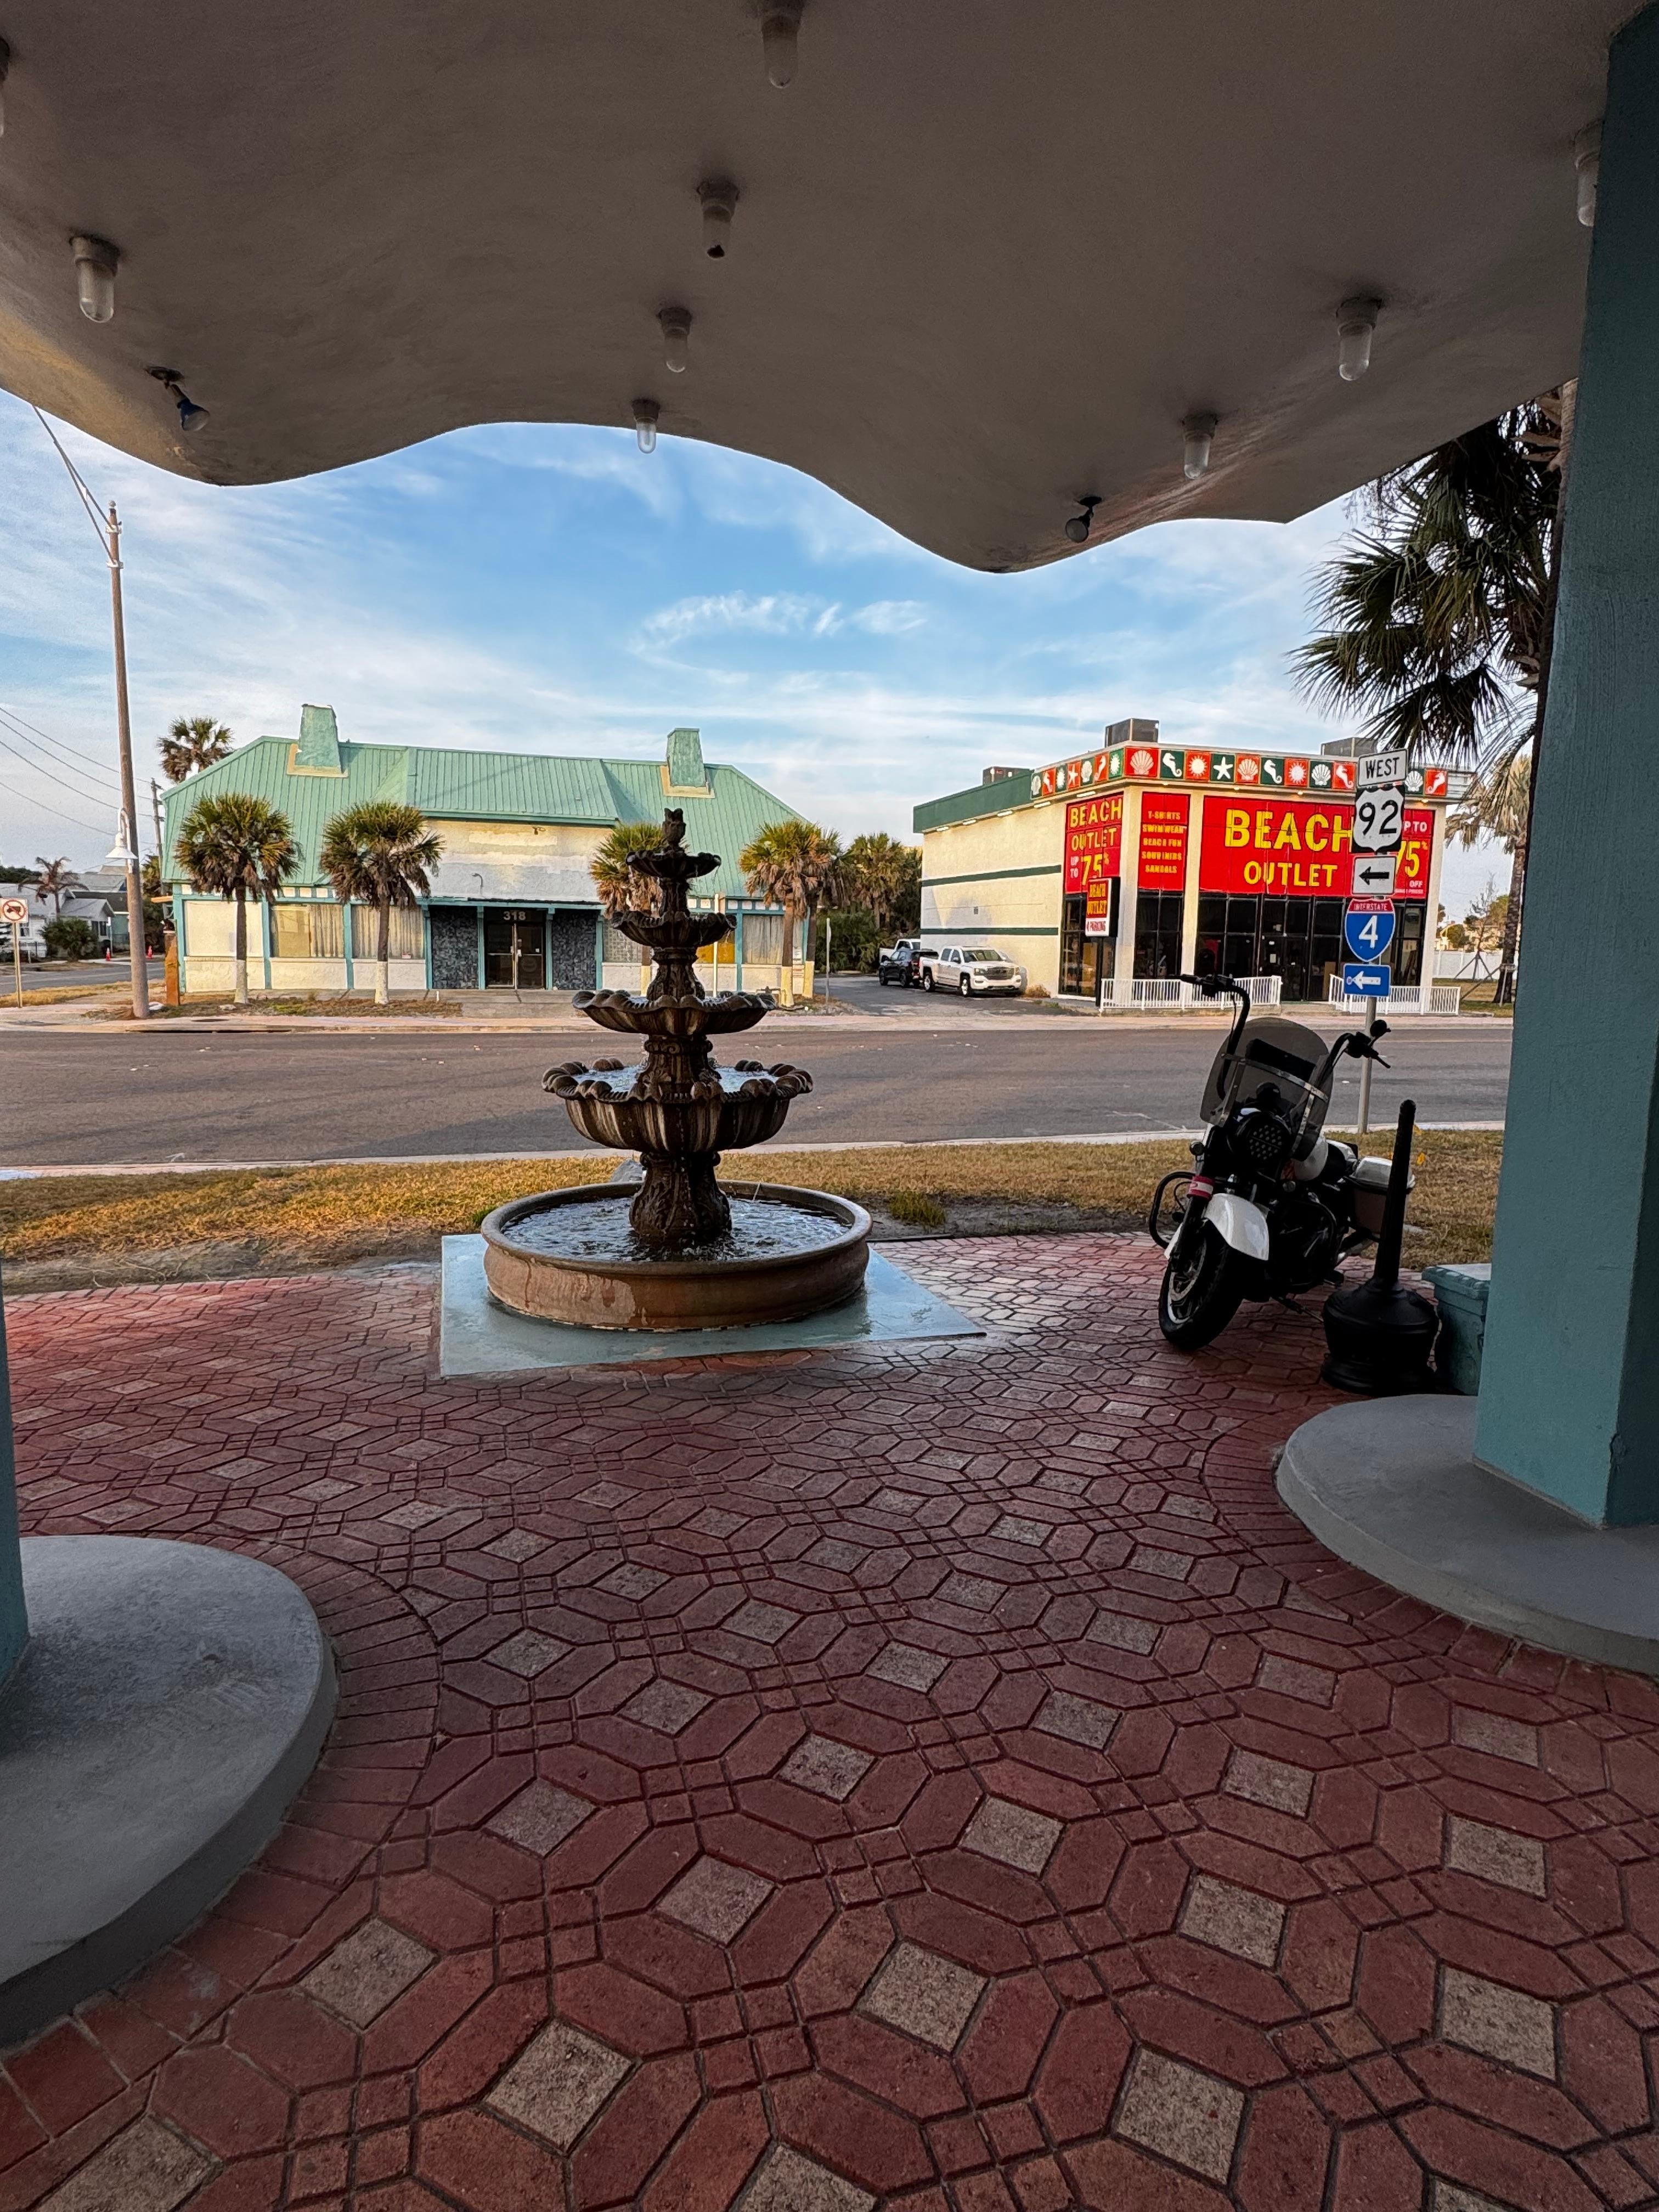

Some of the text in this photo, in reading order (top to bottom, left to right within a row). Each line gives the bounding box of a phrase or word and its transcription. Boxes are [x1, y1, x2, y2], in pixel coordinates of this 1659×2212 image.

[1365, 757, 1400, 779] WEST
[1070, 798, 1122, 828] BEACH
[1148, 811, 1181, 820] T-SHIRTS
[1358, 799, 1399, 836] 92
[1224, 809, 1353, 852] BEACH
[1413, 821, 1427, 833] TO
[1071, 827, 1117, 851] OUTLET
[1143, 838, 1182, 847] BEACH FUN
[1070, 856, 1079, 865] UP
[1070, 868, 1079, 878] TO
[1145, 865, 1177, 873] SANDALS
[1244, 860, 1338, 887] OUTLET
[1409, 880, 1423, 888] OFF
[503, 911, 526, 921] 318
[1358, 915, 1378, 949] 4
